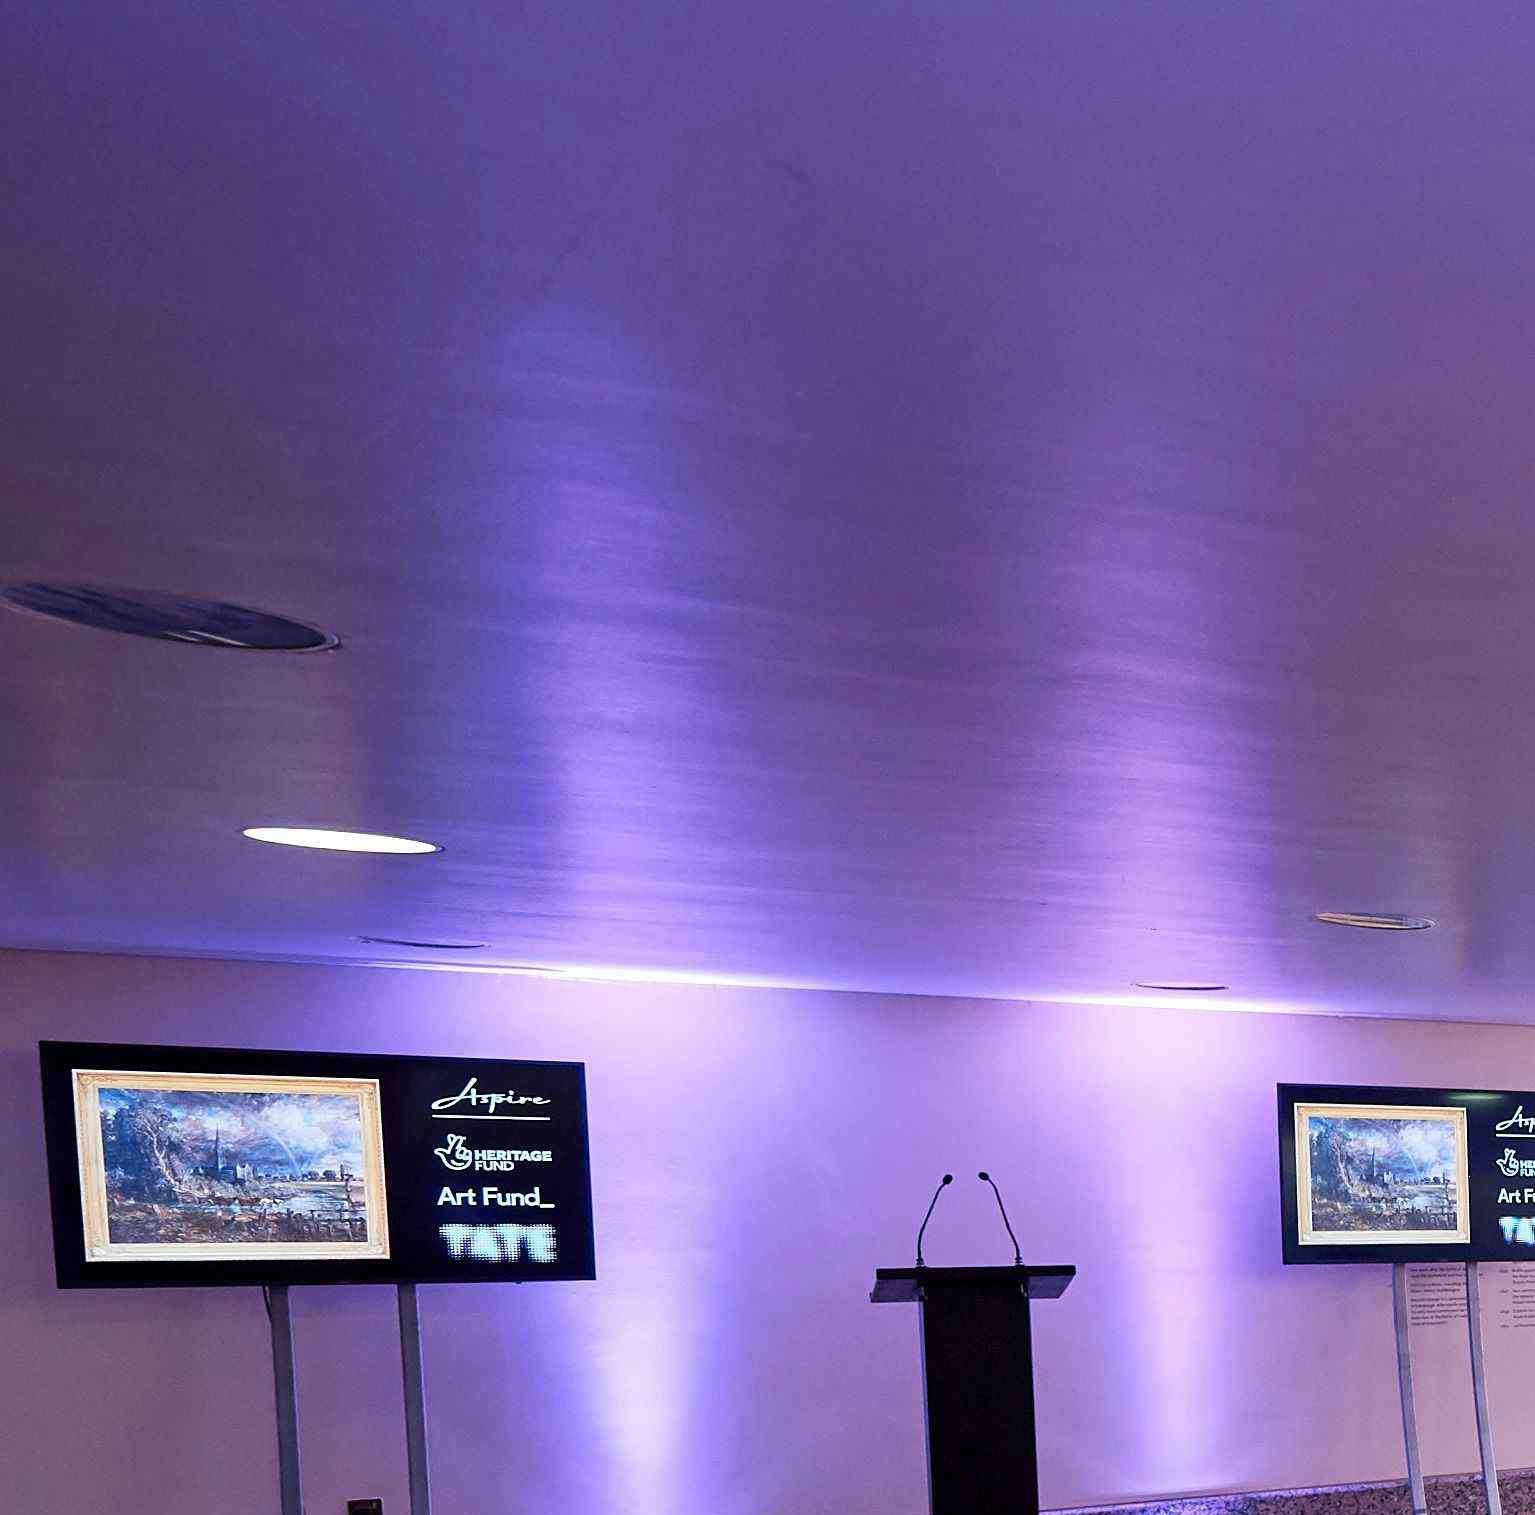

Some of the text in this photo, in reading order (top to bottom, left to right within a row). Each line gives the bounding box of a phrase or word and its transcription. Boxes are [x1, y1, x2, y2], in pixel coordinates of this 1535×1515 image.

[431, 1077, 551, 1113] Aspire
[474, 1150, 553, 1162] HERITAGE
[474, 1161, 515, 1171] FUND
[437, 1186, 477, 1206] Art
[1497, 1188, 1522, 1204] Art
[439, 1223, 558, 1263] TATE
